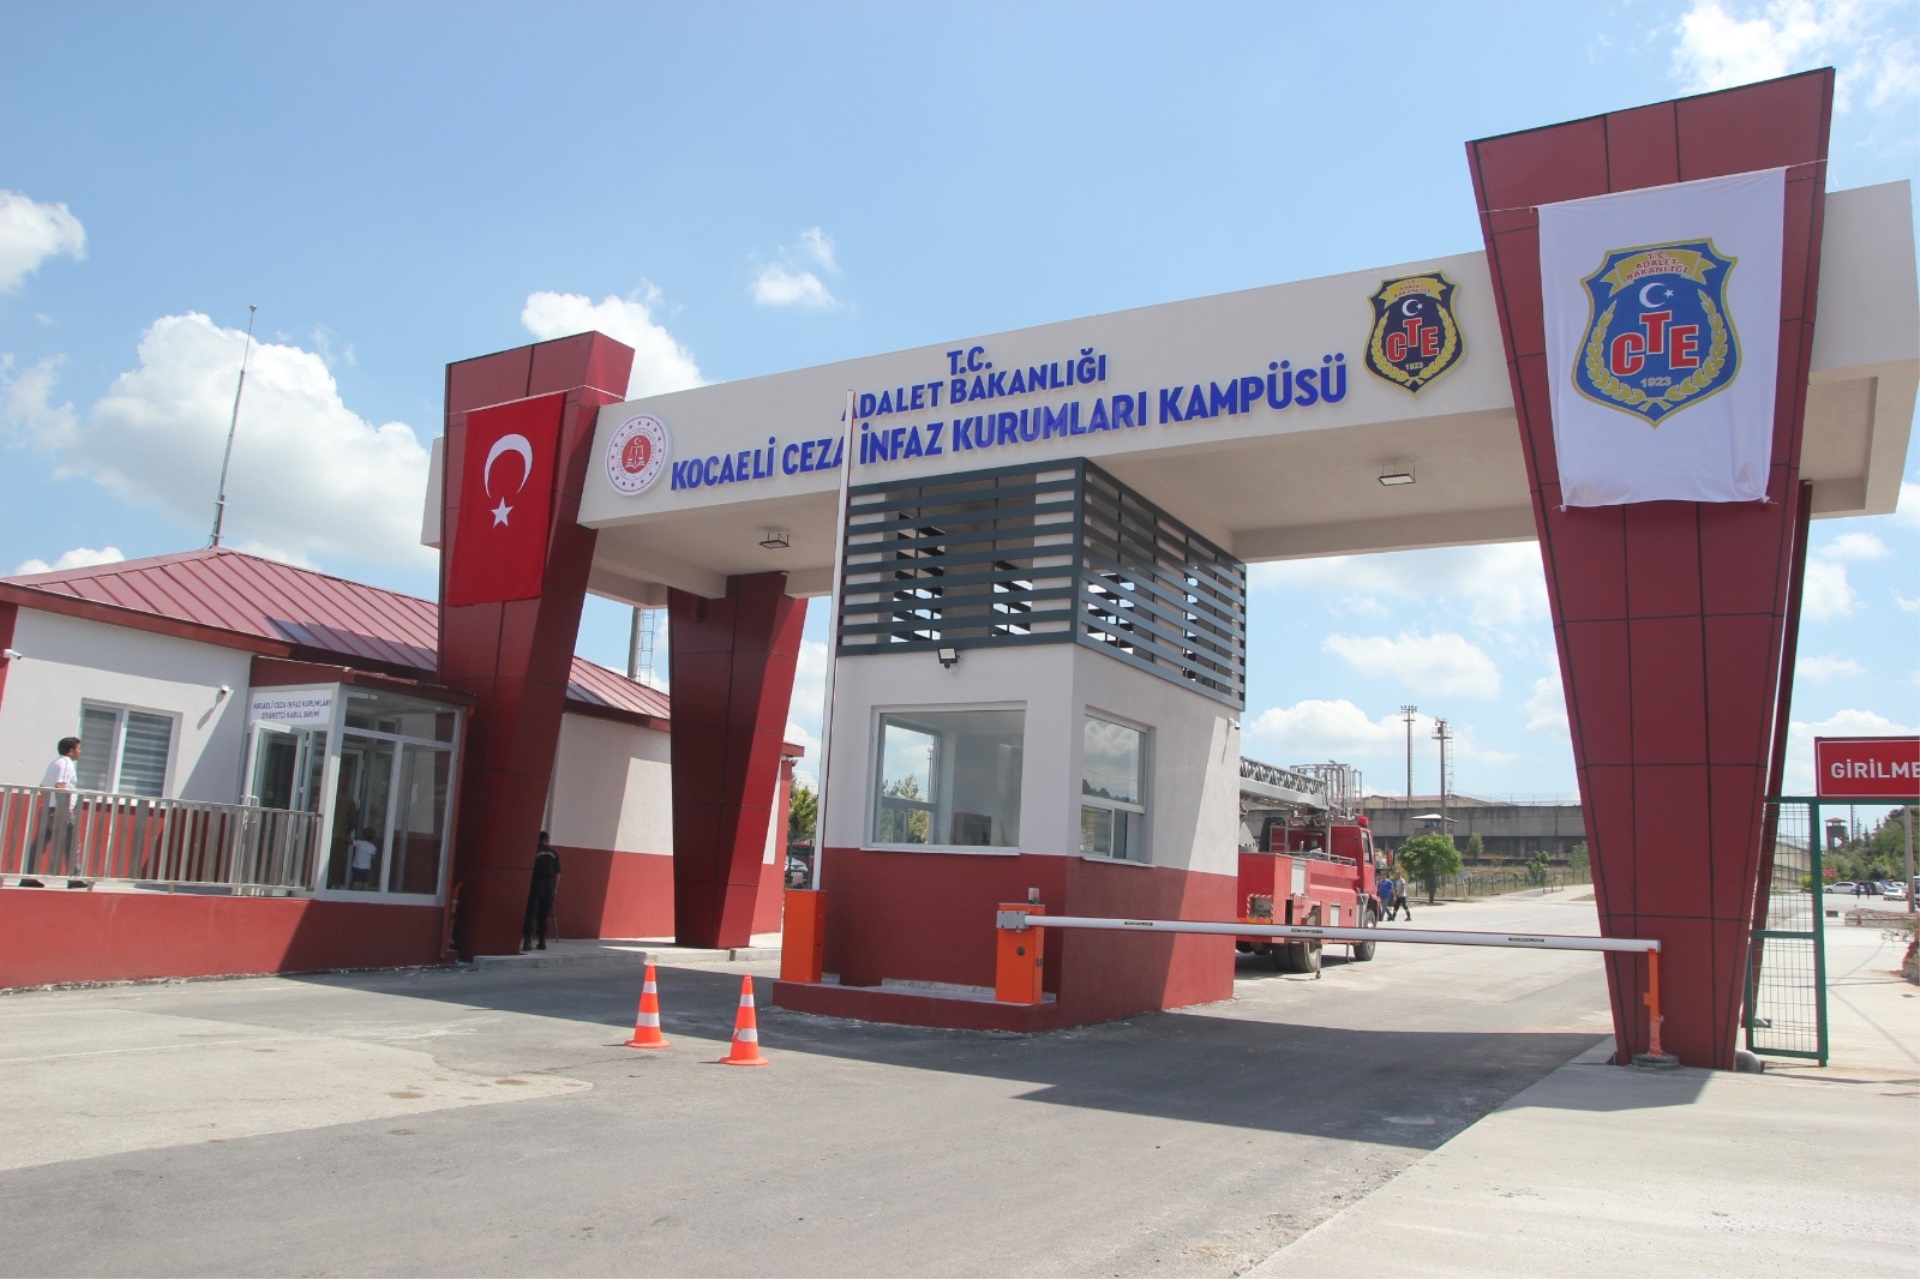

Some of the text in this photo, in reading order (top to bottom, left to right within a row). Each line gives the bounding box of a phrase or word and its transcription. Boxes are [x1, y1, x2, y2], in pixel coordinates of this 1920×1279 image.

[1636, 258, 1678, 269] ADALET
[947, 345, 993, 376] T.C.
[1386, 317, 1439, 363] CTE
[1610, 310, 1699, 376] CTE
[950, 347, 1107, 404] BAKANLIĞI
[1641, 376, 1672, 387] 1923
[671, 437, 776, 491] KOCAELİ
[860, 421, 944, 465] İNFAZ
[952, 391, 1148, 452] KURUMLARI
[1159, 353, 1348, 424] KAMPÜSÜ
